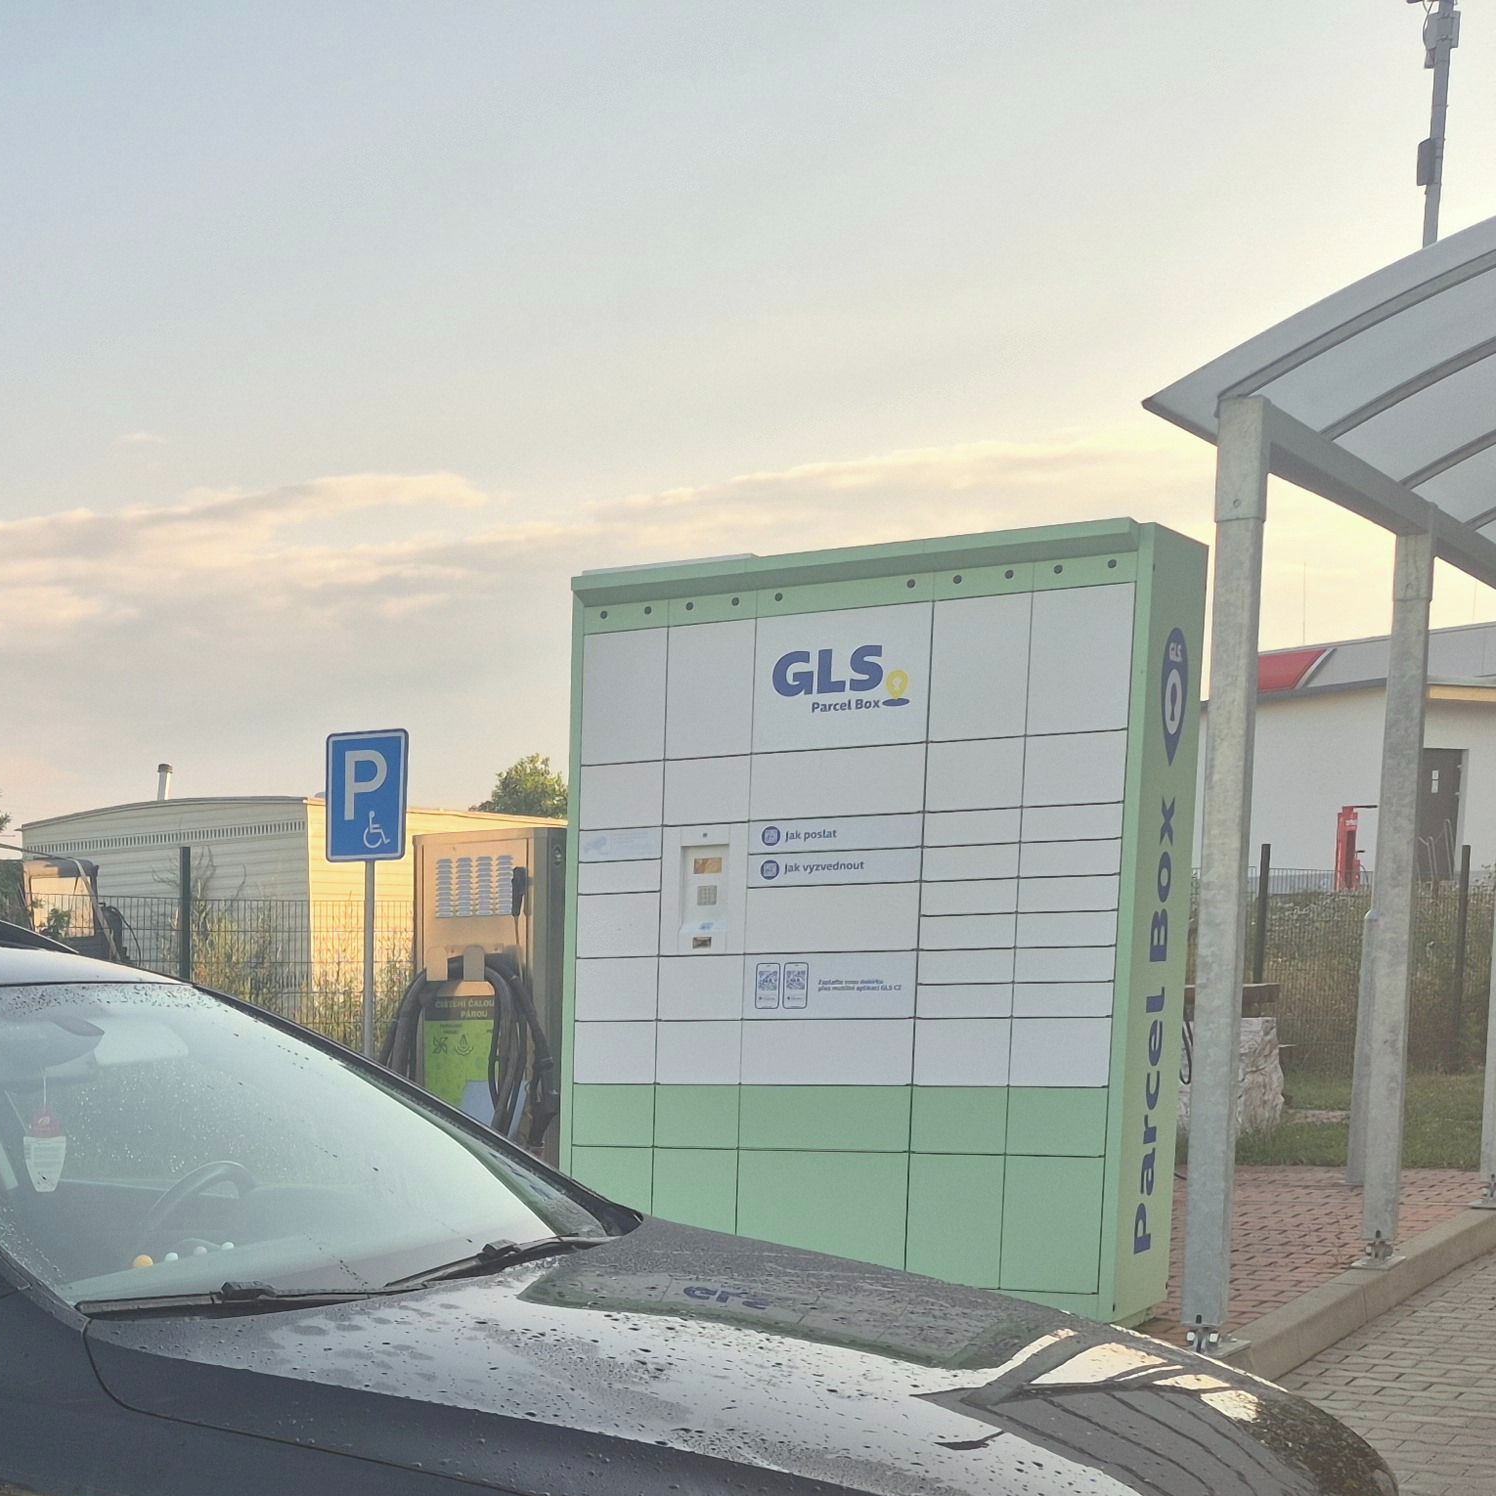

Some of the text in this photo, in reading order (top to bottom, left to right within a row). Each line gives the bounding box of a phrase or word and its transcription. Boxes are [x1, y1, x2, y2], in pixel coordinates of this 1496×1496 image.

[772, 644, 884, 697] GLS
[811, 698, 880, 713] Parcel Box
[343, 749, 388, 821] P
[785, 829, 837, 842] Jak poslat
[784, 861, 865, 875] Jak vyzvednout
[1133, 797, 1175, 1254] Parcel Box
